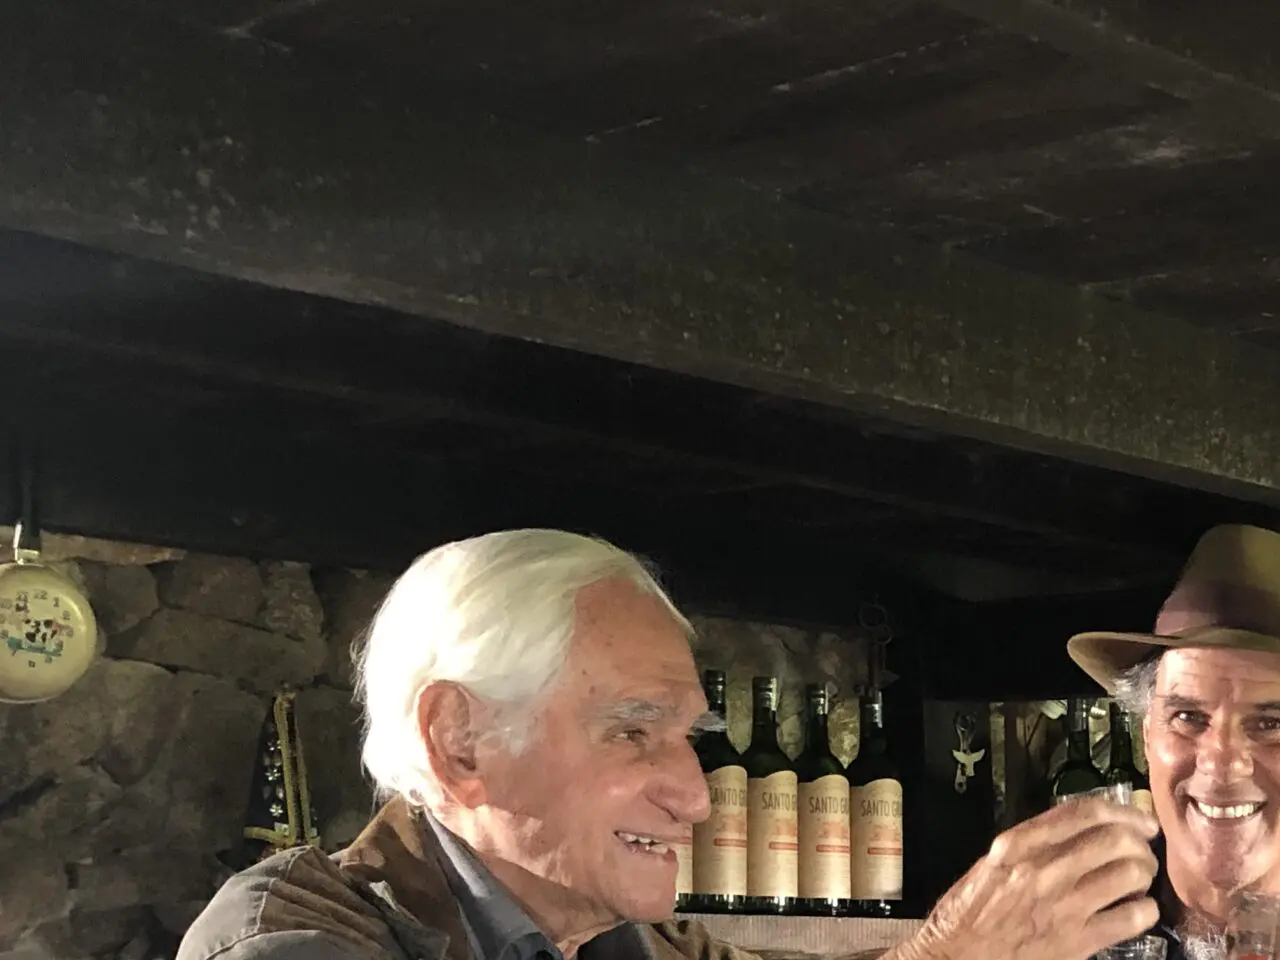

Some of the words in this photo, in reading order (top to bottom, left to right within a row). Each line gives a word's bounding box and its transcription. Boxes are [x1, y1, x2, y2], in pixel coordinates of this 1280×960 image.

[762, 791, 789, 811] SANTO
[809, 796, 839, 814] SANTO
[861, 799, 889, 817] SANTO
